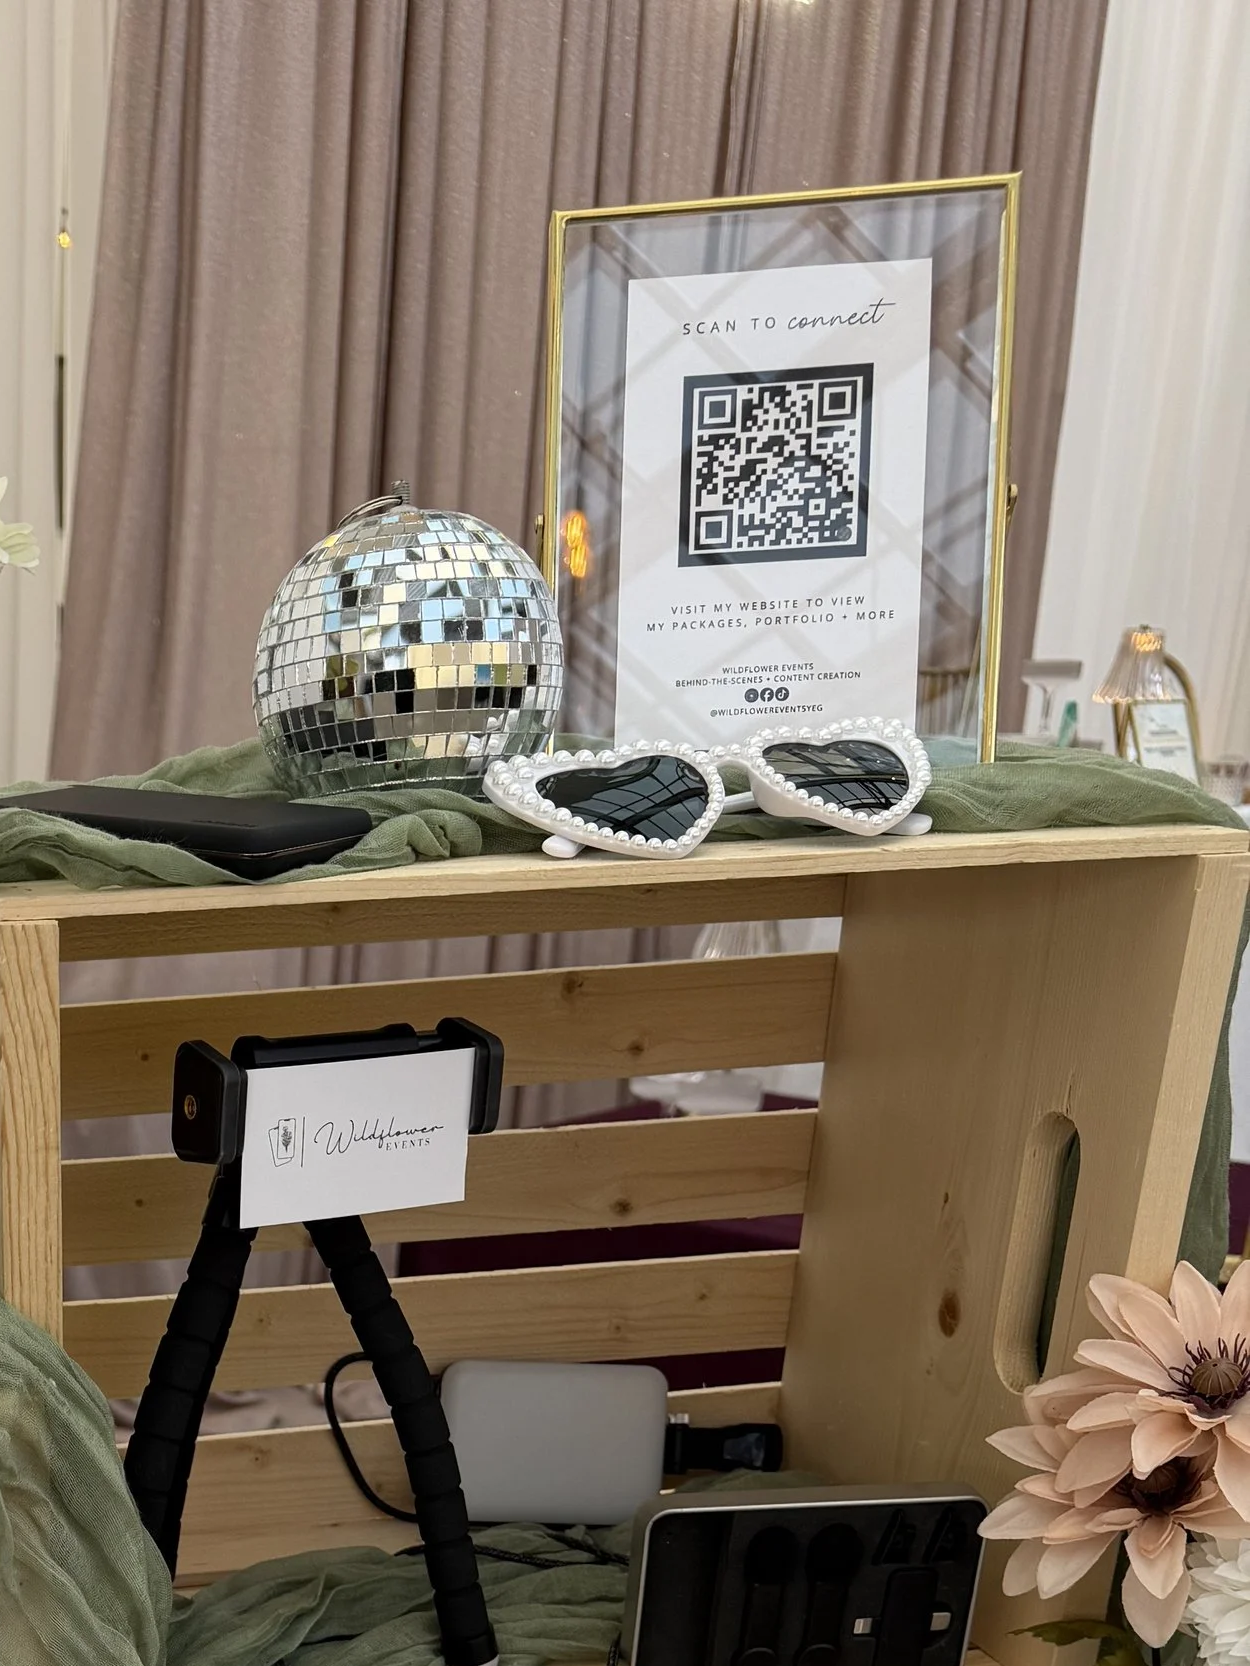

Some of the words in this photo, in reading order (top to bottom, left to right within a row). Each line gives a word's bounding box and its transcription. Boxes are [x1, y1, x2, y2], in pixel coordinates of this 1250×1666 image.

[682, 320, 735, 335] SCAN
[751, 318, 776, 331] TO
[788, 297, 896, 329] connect
[671, 604, 706, 615] VISIT
[713, 603, 732, 613] MY
[739, 600, 799, 611] WEBSITE
[806, 598, 824, 608] TO
[831, 596, 866, 606] VIEW
[646, 623, 665, 632] MY
[672, 618, 747, 631] PACKAGES,
[755, 613, 834, 626] PORTFOLIO
[856, 609, 895, 621] MORE
[722, 664, 779, 674] WILDFLOWER
[781, 662, 814, 671] EVENTS
[675, 676, 763, 688] BEHIND-THE-SCENES
[774, 673, 814, 683] CONTENT
[817, 671, 861, 680] CREATION
[710, 704, 823, 717] @WILDFLOWEREVENTSYEG
[313, 1117, 444, 1156] Wildflower
[386, 1139, 431, 1151] EVENTS
